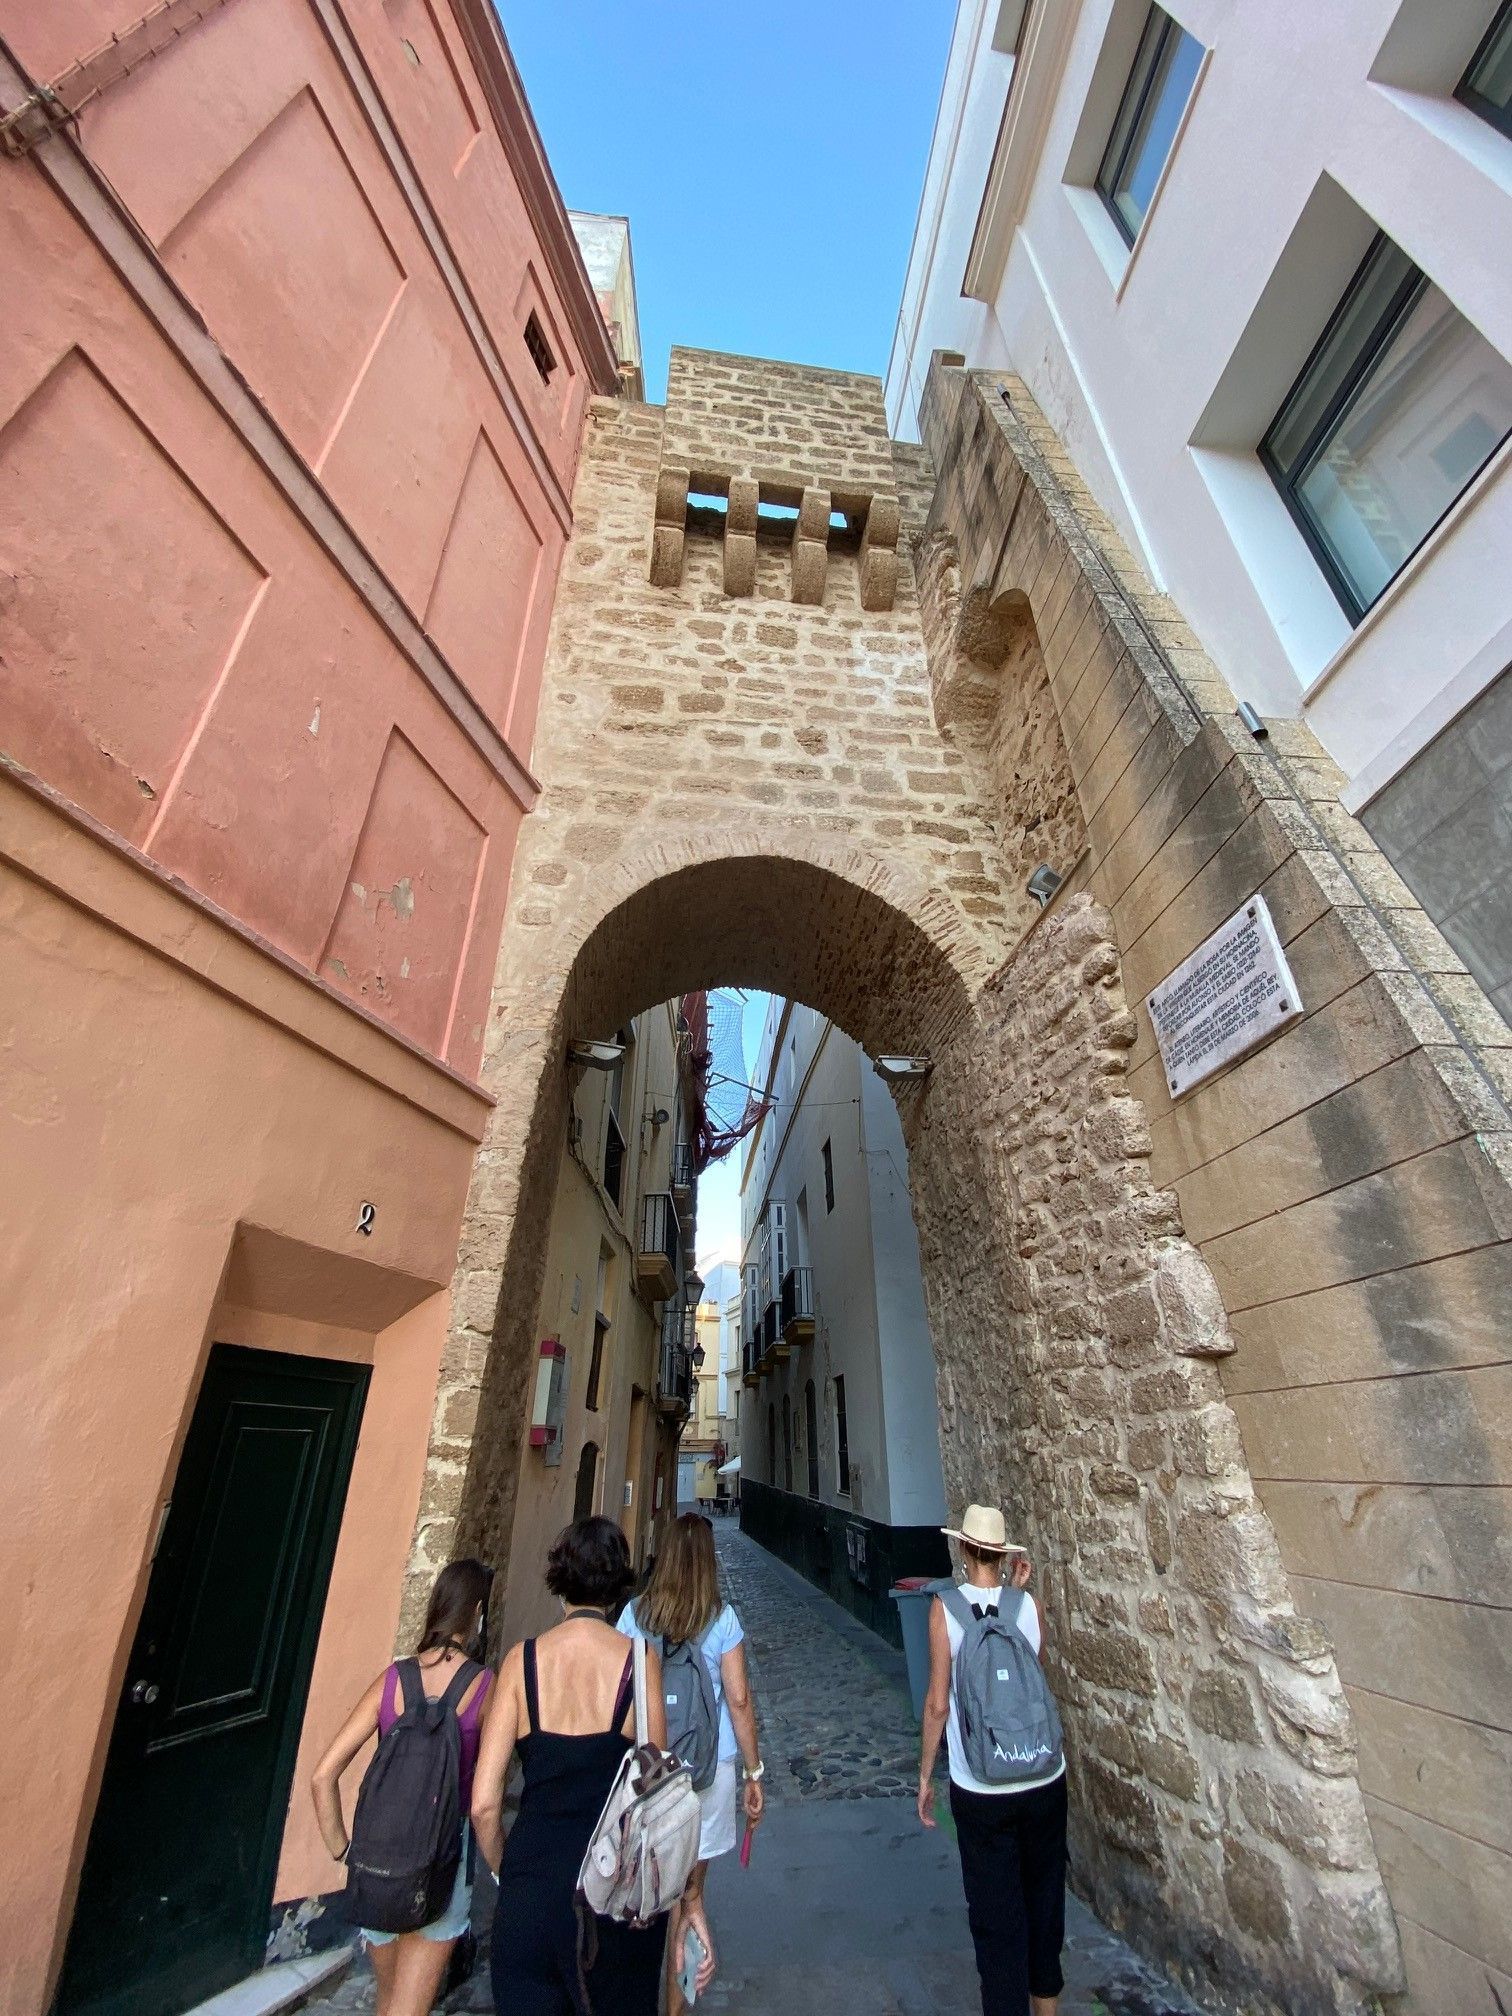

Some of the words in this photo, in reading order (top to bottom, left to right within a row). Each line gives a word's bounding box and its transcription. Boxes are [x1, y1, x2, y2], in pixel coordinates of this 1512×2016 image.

[1206, 951, 1219, 966] ROSA
[1237, 916, 1257, 939] IMAGEN
[1217, 976, 1236, 996] CIUDAD
[1266, 982, 1280, 997] ESTA
[356, 1204, 375, 1236] 2
